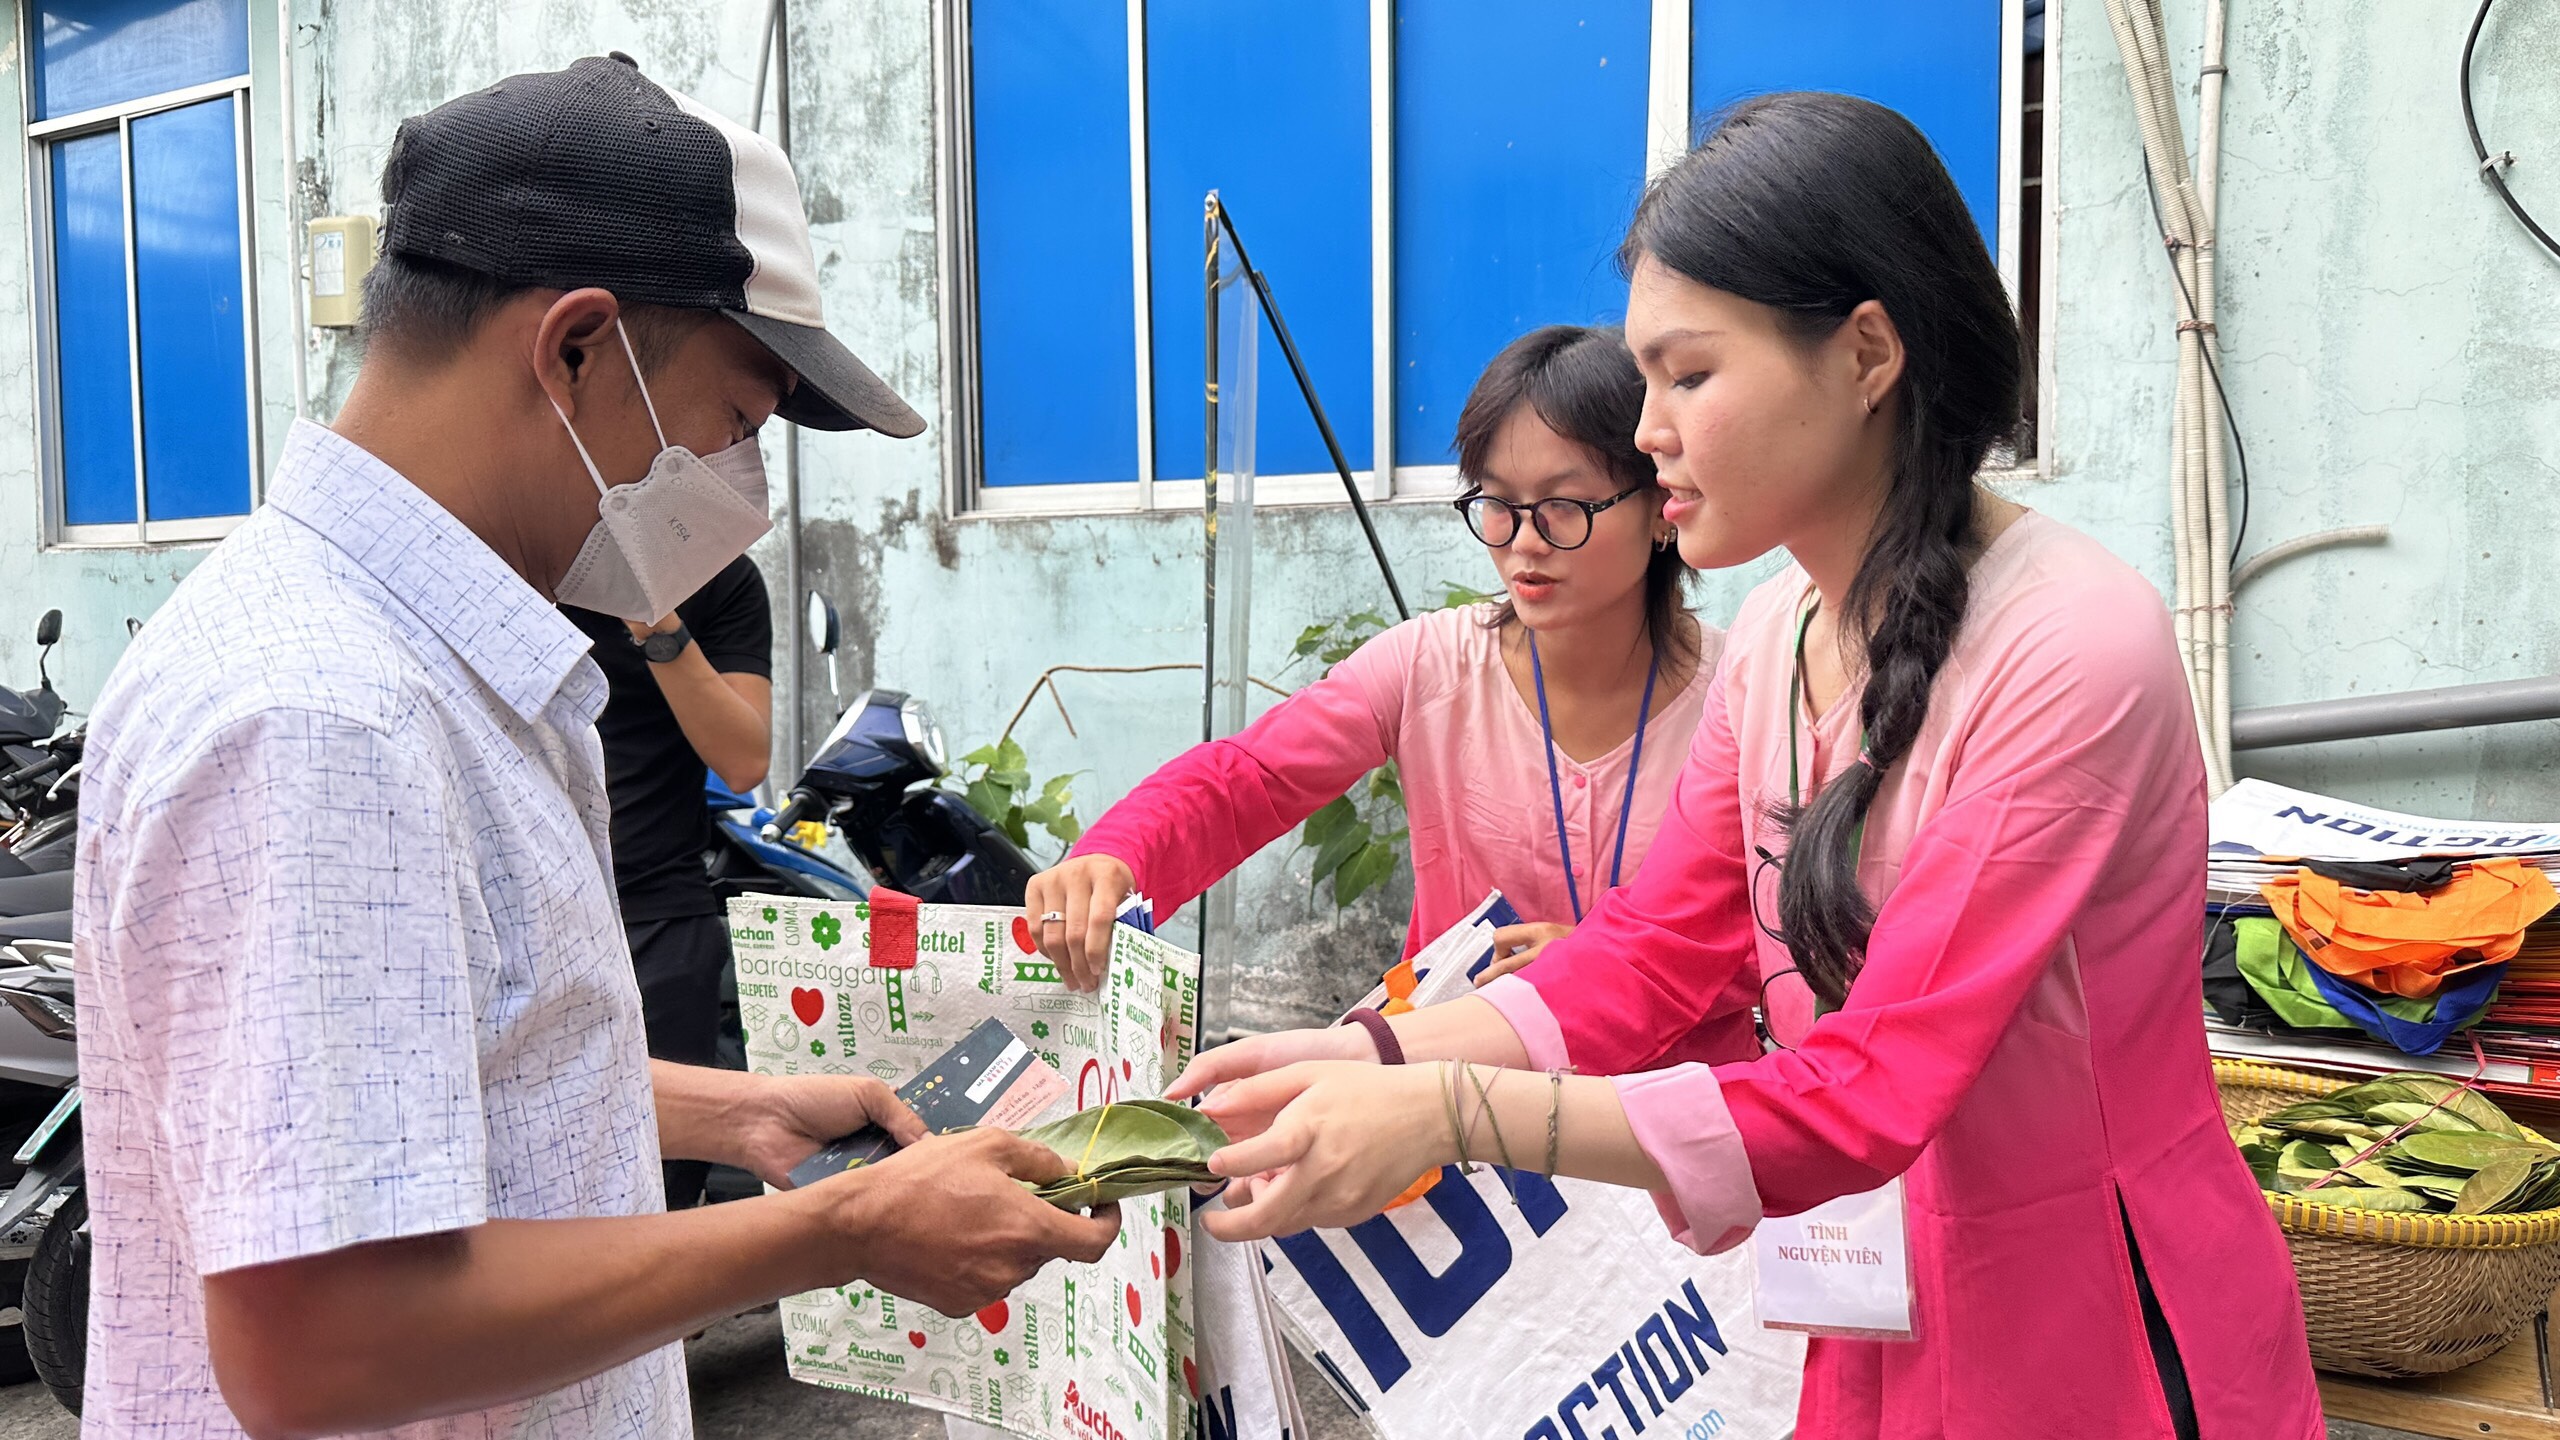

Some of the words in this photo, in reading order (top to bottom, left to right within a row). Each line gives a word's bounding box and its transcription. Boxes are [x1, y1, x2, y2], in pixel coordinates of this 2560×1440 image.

[667, 516, 691, 542] KF94
[2273, 805, 2548, 848] ACTION
[732, 927, 775, 941] uchan
[783, 901, 801, 946] CSOMAG
[740, 952, 887, 988] barátsággal
[979, 921, 996, 994] Auchan
[737, 981, 779, 999] EGLEPETÉS
[1180, 972, 1199, 1028] meg
[1039, 998, 1084, 1013] szeress
[838, 992, 857, 1058] változz
[884, 1034, 944, 1049] barátsággal
[1808, 1222, 1848, 1241] TÌNH
[1778, 1245, 1841, 1266] NGUYỆN
[1845, 1247, 1882, 1265] VIÊN
[791, 1312, 832, 1337] CSOMAG
[1023, 1302, 1039, 1370] változz
[794, 1355, 849, 1373] Auchan.hu
[847, 1342, 906, 1364] Auchan
[1063, 1379, 1127, 1440] Aucha
